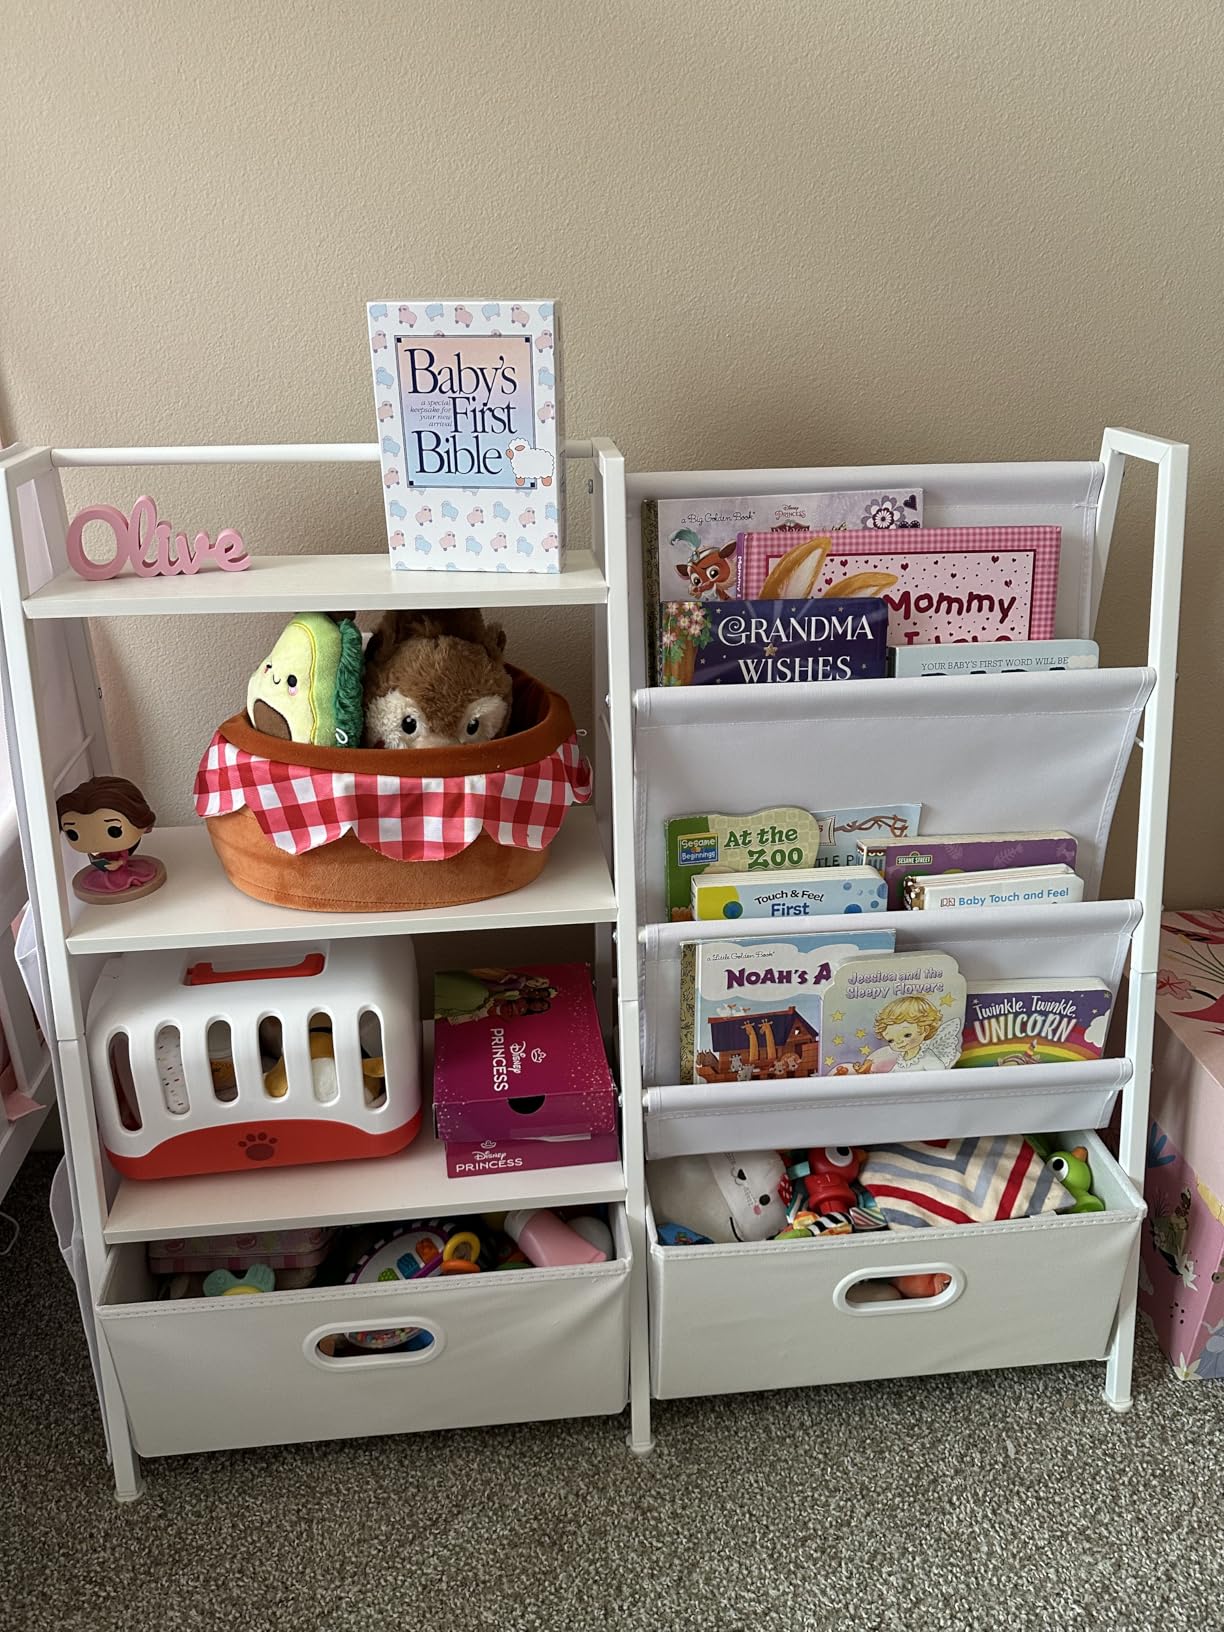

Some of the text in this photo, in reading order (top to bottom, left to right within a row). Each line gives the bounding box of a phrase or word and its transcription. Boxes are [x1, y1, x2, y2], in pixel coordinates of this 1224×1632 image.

[404, 348, 518, 407] Baby's
[410, 406, 440, 414] keepsake
[448, 396, 518, 434] First
[411, 430, 503, 475] Bible
[687, 514, 703, 526] Big
[705, 512, 732, 522] Golden
[67, 495, 252, 581] Olive
[883, 590, 1016, 624] Mommy
[718, 615, 874, 646] GRANDMA
[738, 655, 852, 683] WISHES
[922, 656, 1069, 671] YOUR BABY'S FIRST WORD WILL BE
[682, 838, 716, 849] Sesame
[724, 830, 752, 848] At
[757, 826, 798, 844] the
[682, 851, 716, 860] Beginnings
[754, 889, 824, 904] Touch & Feel
[958, 896, 986, 907] Baby
[990, 892, 1020, 903] Touch
[1023, 890, 1044, 900] and
[1047, 887, 1069, 898] Feel
[771, 902, 810, 917] First
[848, 967, 943, 985] Jessica and the
[846, 981, 944, 999] Sleepy Flowers
[973, 1013, 1077, 1044] UNICORN
[490, 1028, 509, 1092] PRINCESS
[456, 1157, 524, 1173] PRINCESS
